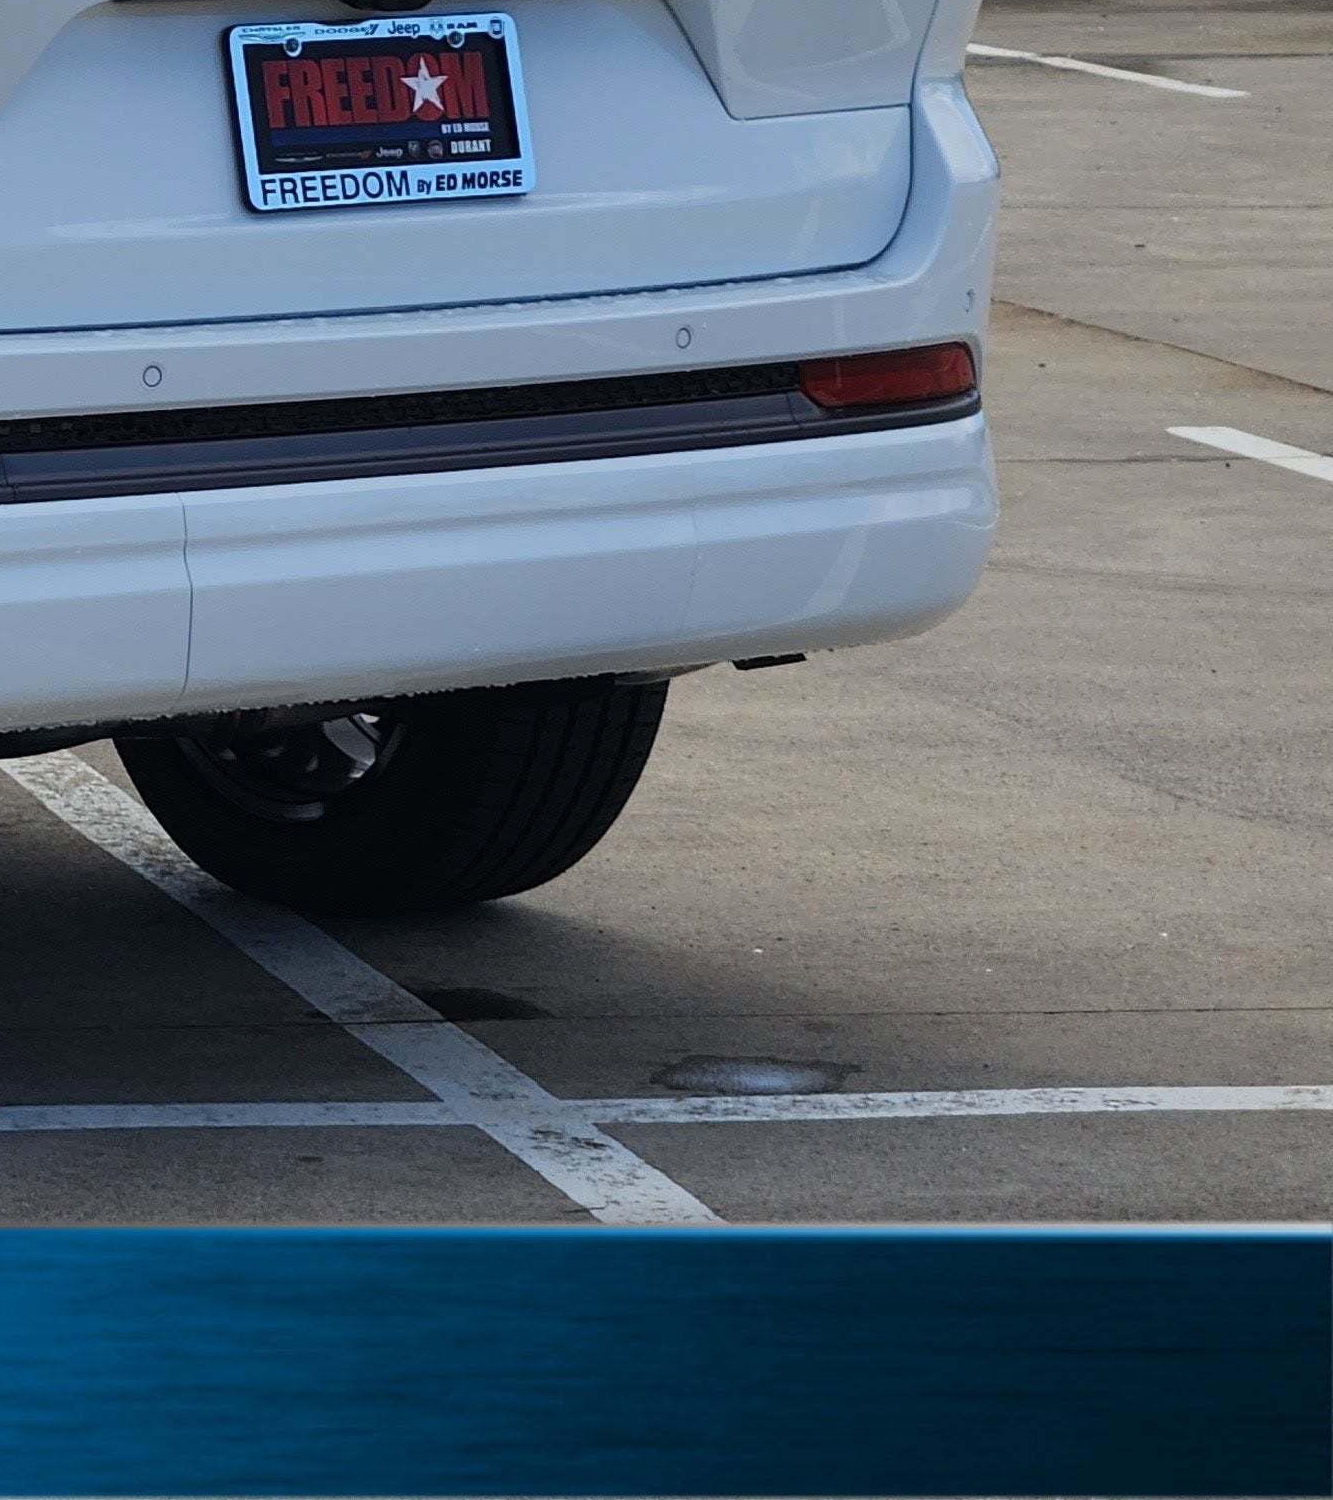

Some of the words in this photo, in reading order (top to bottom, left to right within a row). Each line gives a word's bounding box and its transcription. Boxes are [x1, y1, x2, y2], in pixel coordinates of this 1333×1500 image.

[387, 21, 421, 35] Jeep
[263, 52, 489, 128] FREEDOM
[376, 147, 404, 159] Jeep
[450, 139, 492, 154] DURANT
[261, 171, 410, 205] FREEDOM
[435, 174, 457, 192] ED
[461, 170, 523, 190] MORSE
